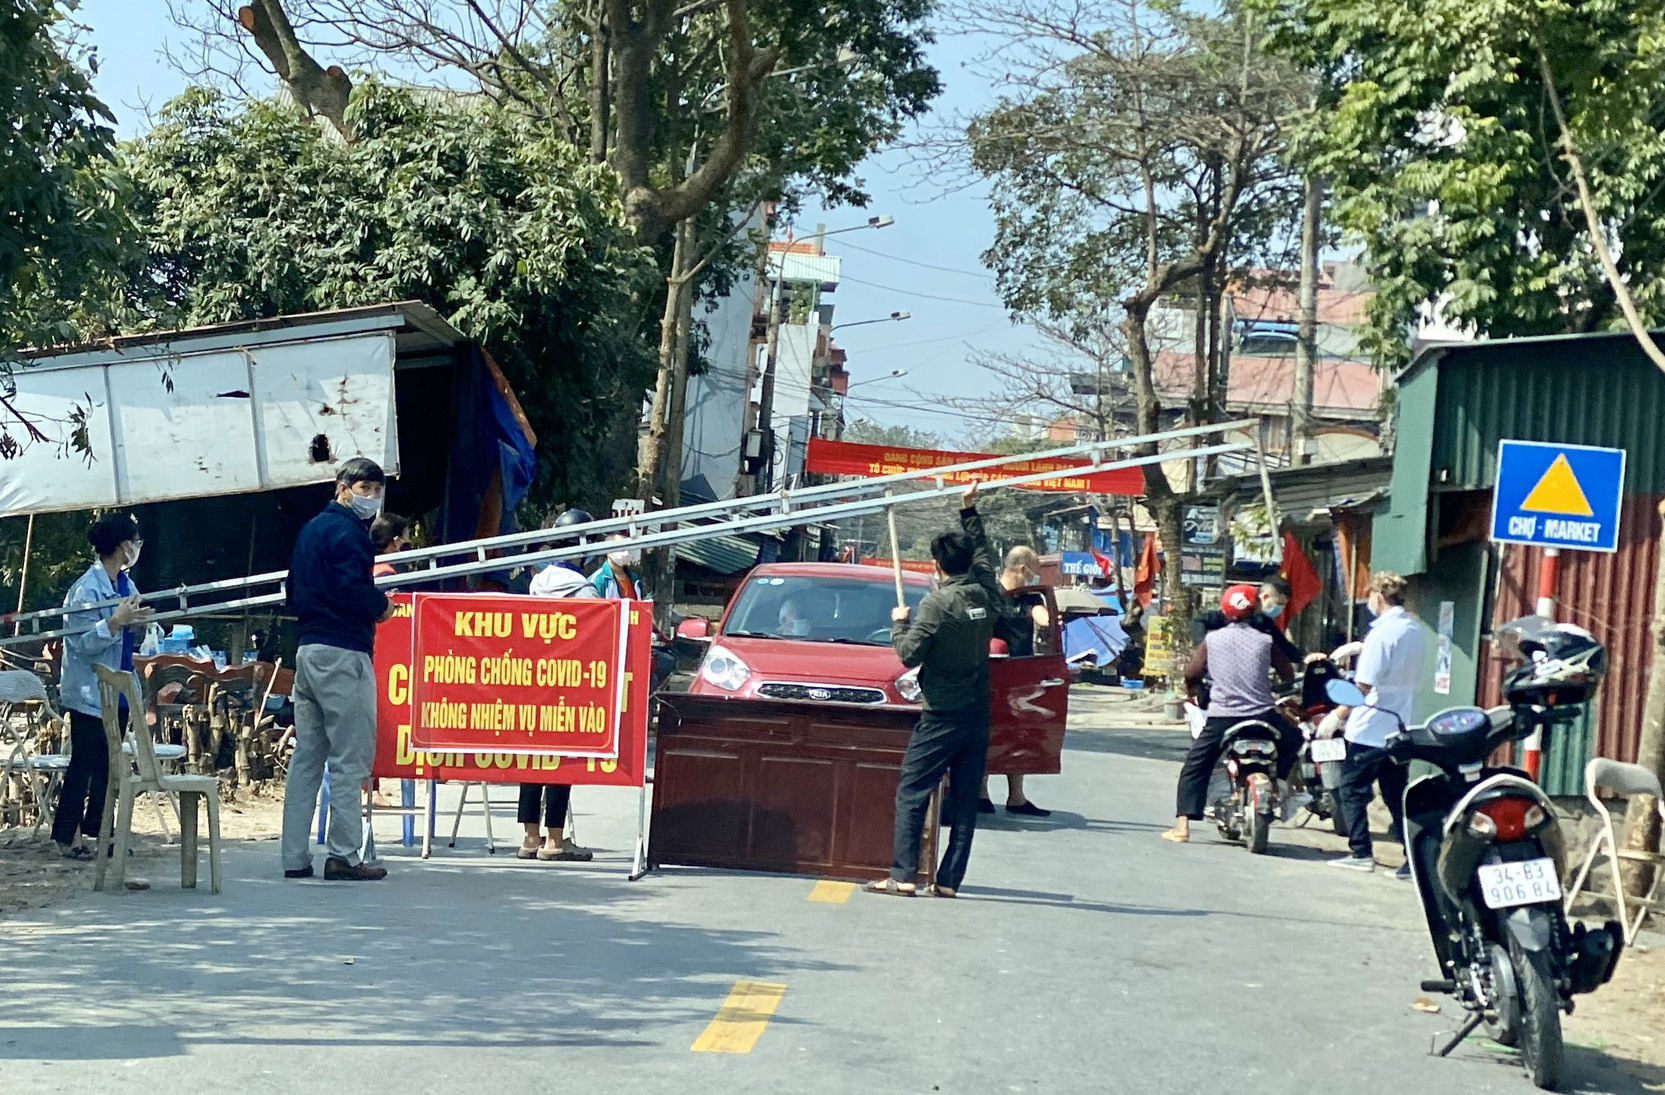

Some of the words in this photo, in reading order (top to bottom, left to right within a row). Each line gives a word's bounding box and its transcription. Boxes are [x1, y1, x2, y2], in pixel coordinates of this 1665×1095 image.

[1064, 478, 1085, 489] NAM
[1508, 515, 1538, 540] CHỢ
[1543, 518, 1601, 543] MARKET
[1064, 560, 1082, 574] THẾ
[454, 611, 513, 638] KHU
[521, 611, 578, 645] VỰC
[424, 648, 477, 685] PHÒNG
[480, 648, 533, 687] CHỐNG
[536, 658, 607, 689] COVID-19
[421, 697, 468, 730] KHÔNG
[470, 698, 515, 736] NHIỆM
[519, 704, 537, 737] VỤ
[539, 695, 575, 733] MIỄN
[578, 701, 606, 734] VÀO
[1493, 862, 1544, 884] 34-B3
